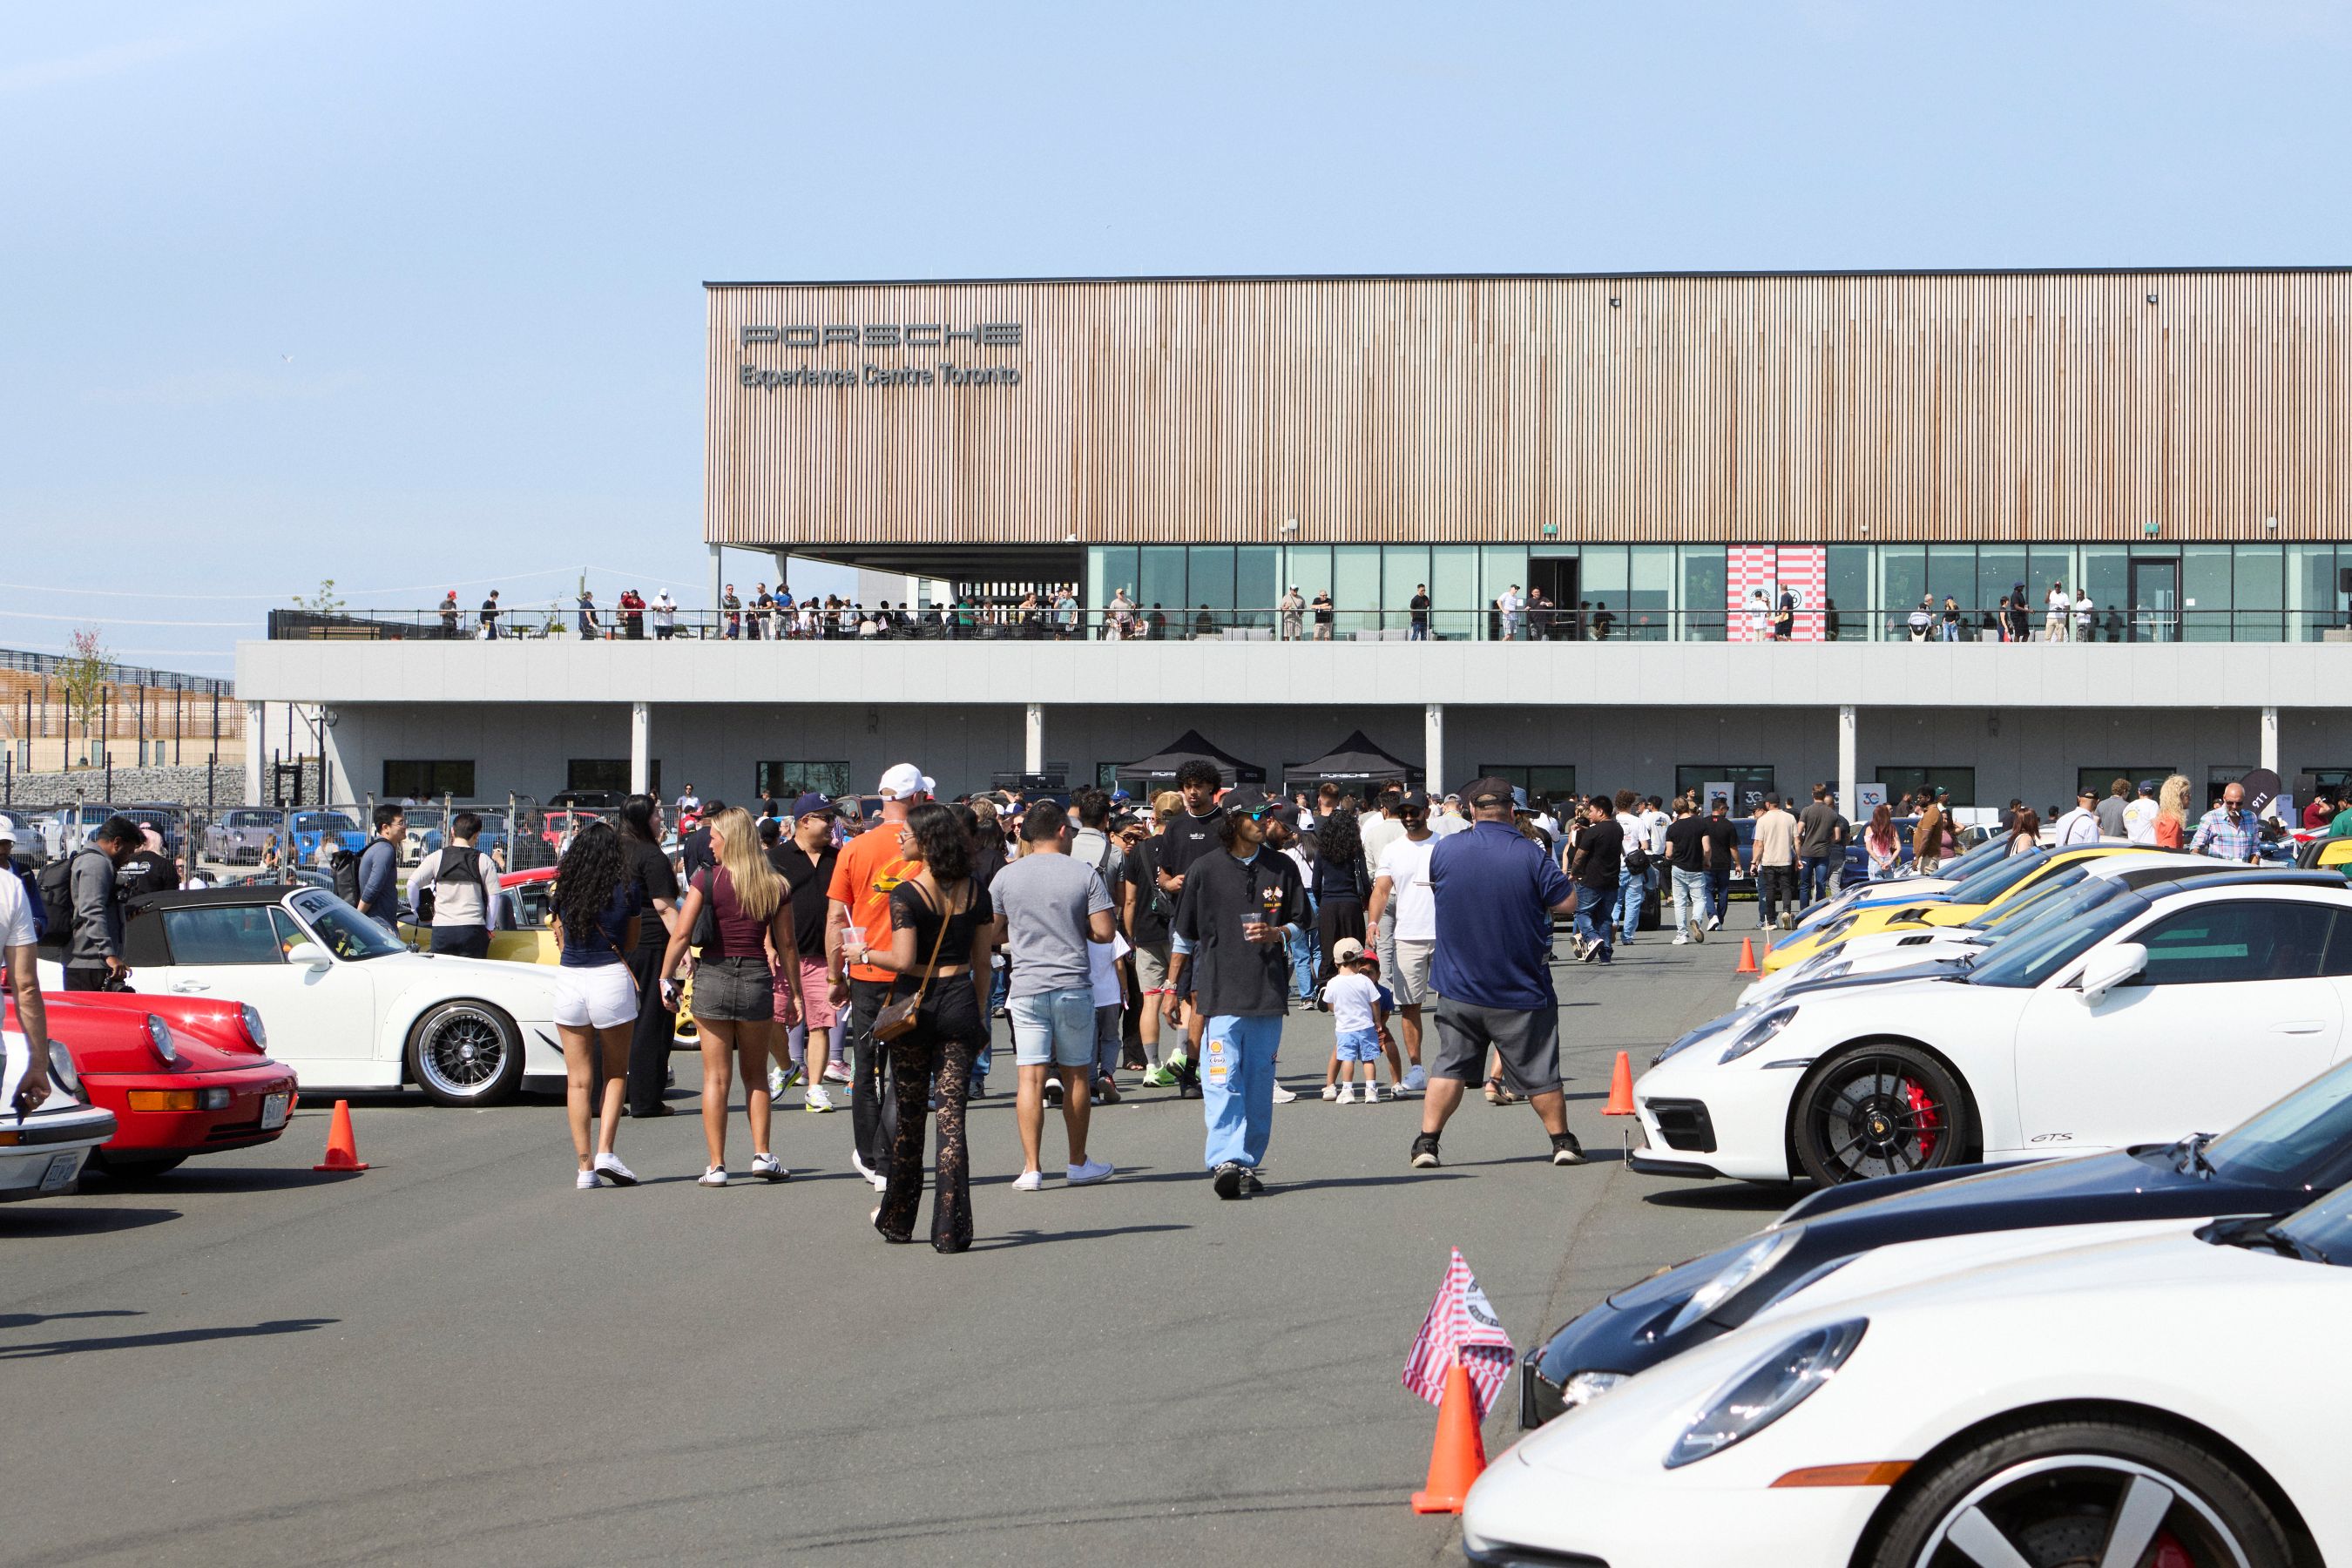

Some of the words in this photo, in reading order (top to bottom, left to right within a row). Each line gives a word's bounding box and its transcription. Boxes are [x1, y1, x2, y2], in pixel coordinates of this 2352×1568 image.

[741, 323, 1021, 347] PORSCHE
[741, 364, 857, 393] Experience
[862, 363, 933, 385] Centre
[938, 362, 1020, 384] Toronto
[2252, 792, 2268, 808] 911
[2031, 1132, 2073, 1142] GTS
